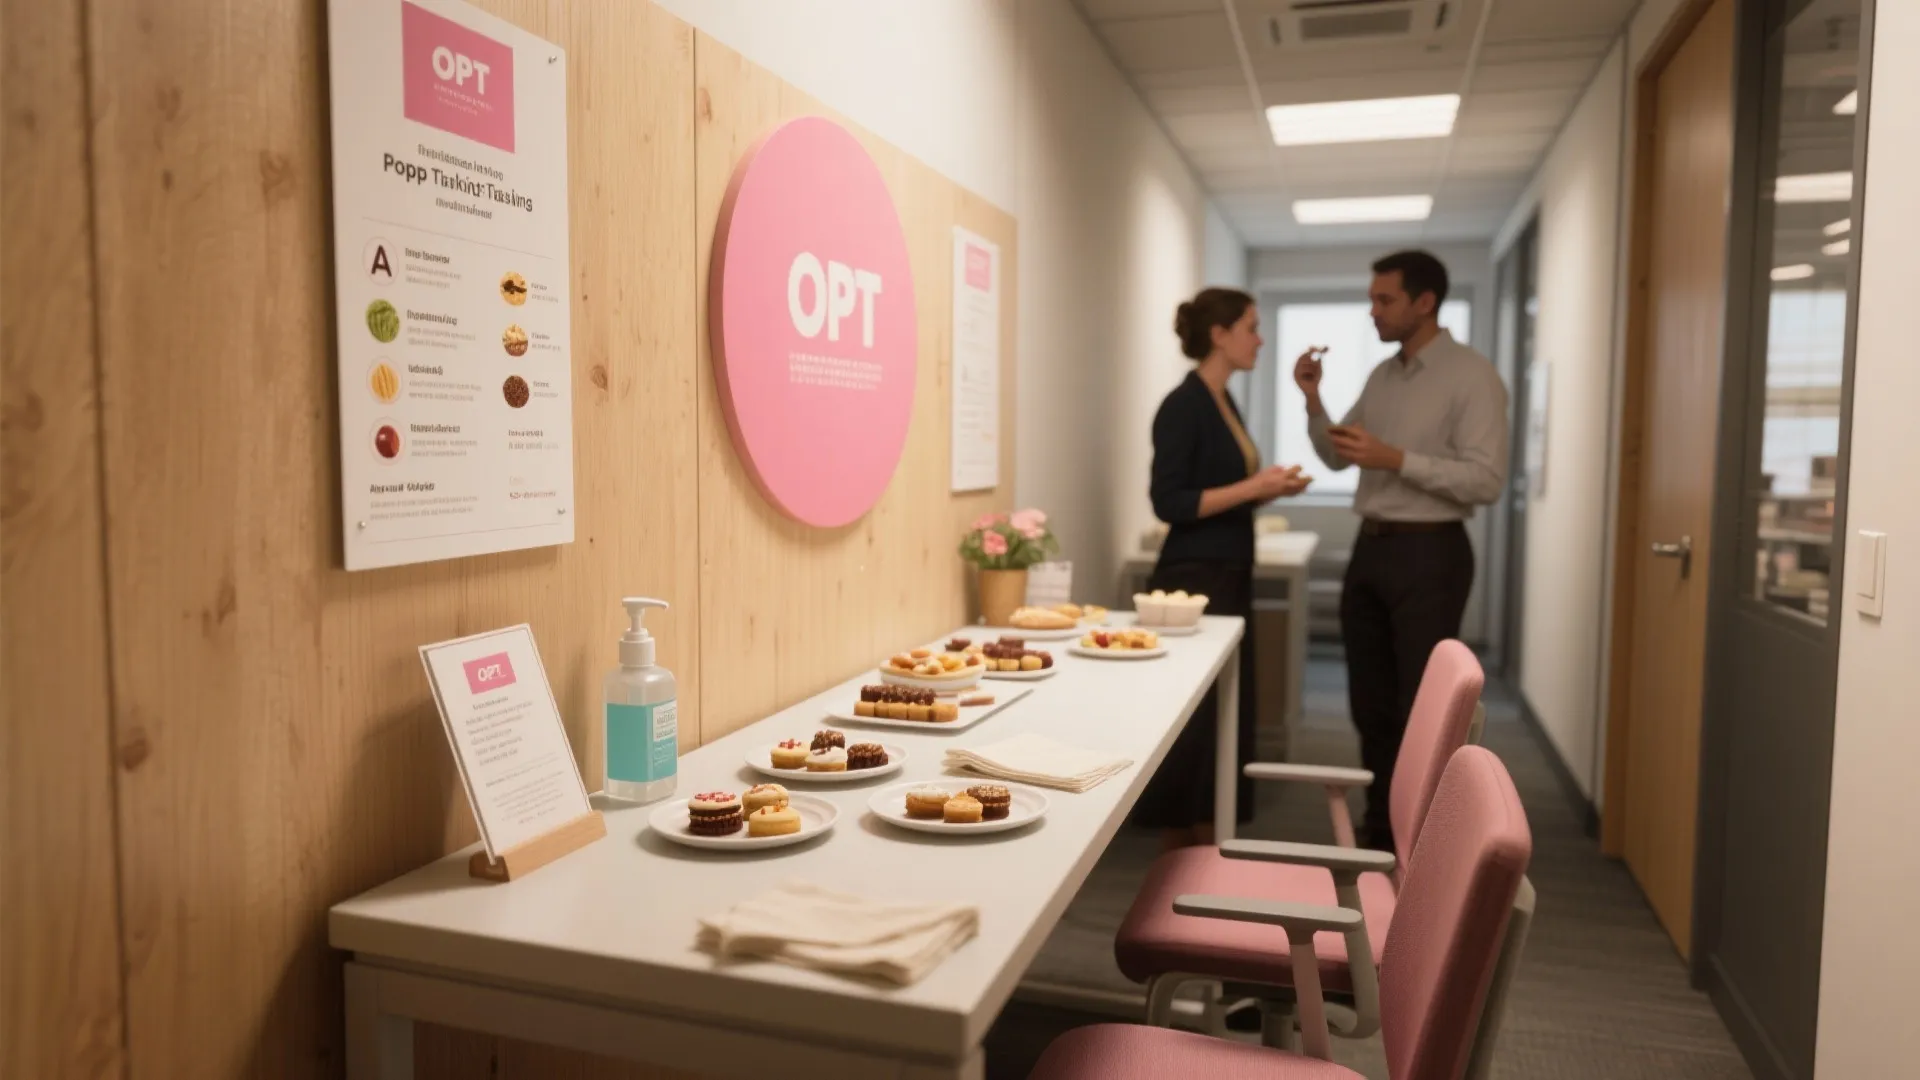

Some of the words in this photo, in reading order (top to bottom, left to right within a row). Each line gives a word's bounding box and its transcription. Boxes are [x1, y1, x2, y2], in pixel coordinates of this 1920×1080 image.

[431, 46, 490, 95] OPT
[383, 152, 427, 185] Popp
[371, 244, 393, 277] A
[788, 251, 882, 349] OPT
